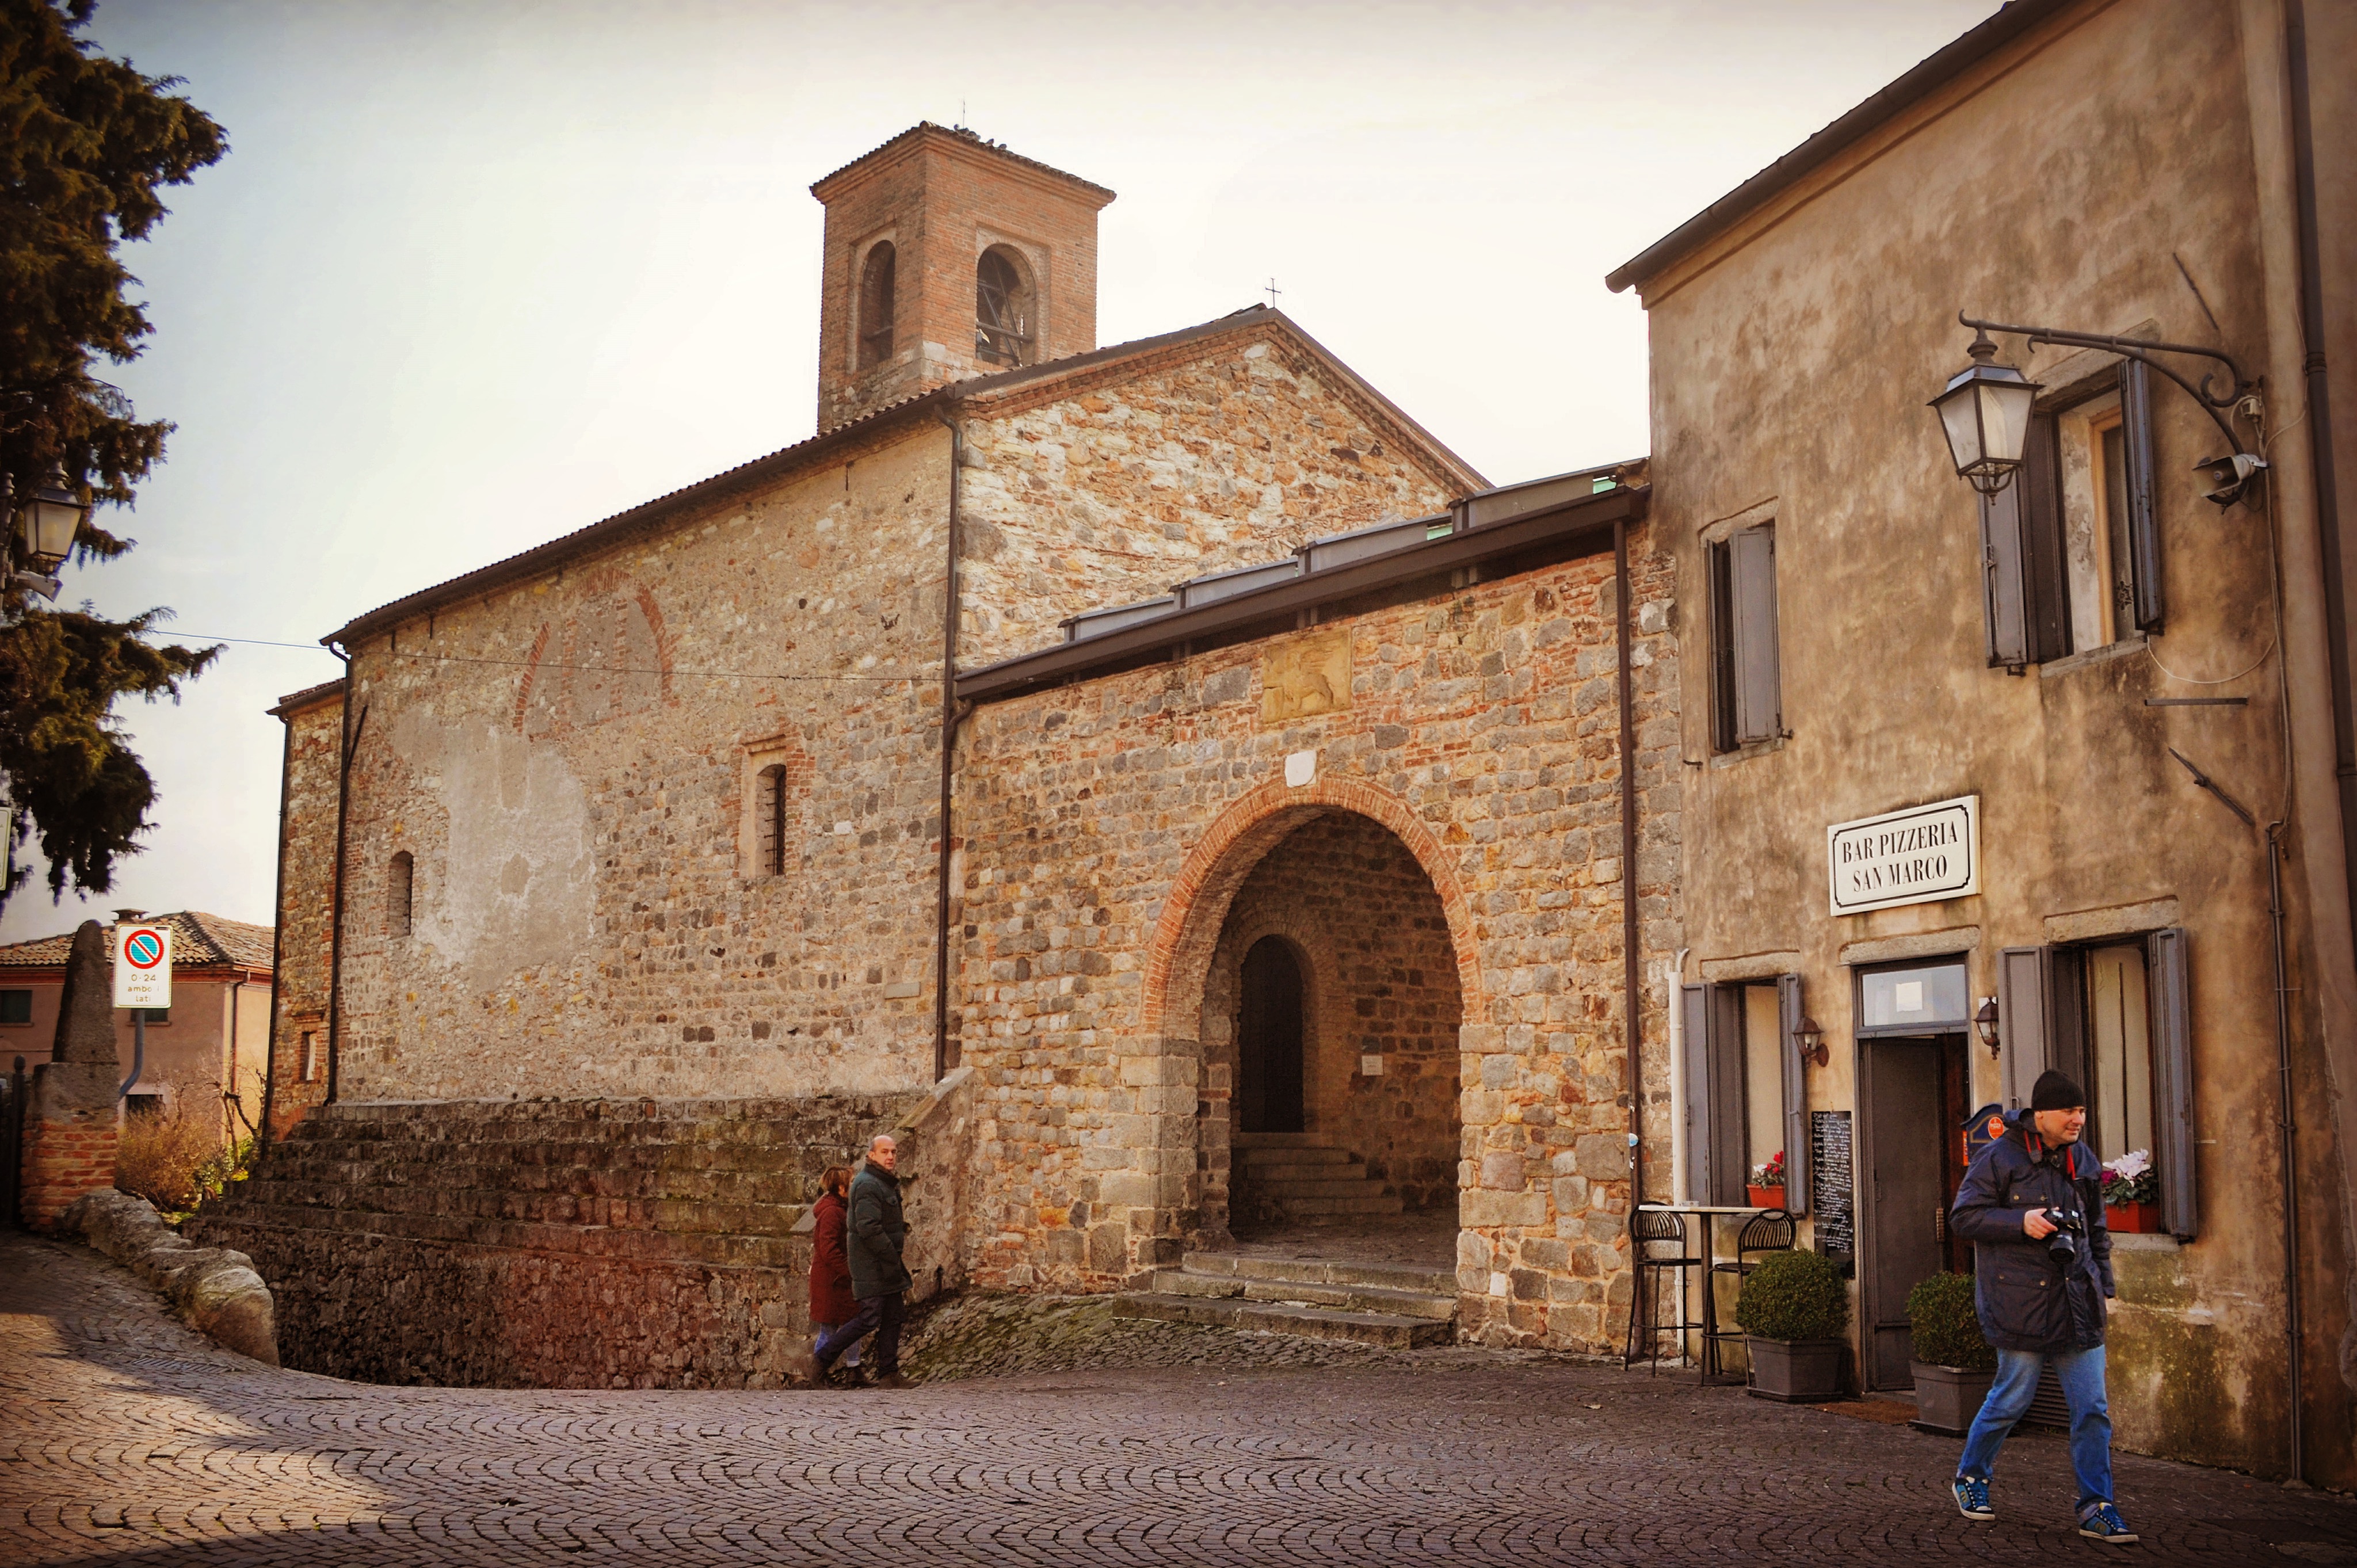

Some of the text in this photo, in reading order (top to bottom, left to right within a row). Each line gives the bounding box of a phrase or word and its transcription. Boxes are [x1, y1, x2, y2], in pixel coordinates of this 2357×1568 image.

[1843, 821, 1958, 864] BAR PIZZERIA
[1853, 854, 1947, 892] SAN MARCO
